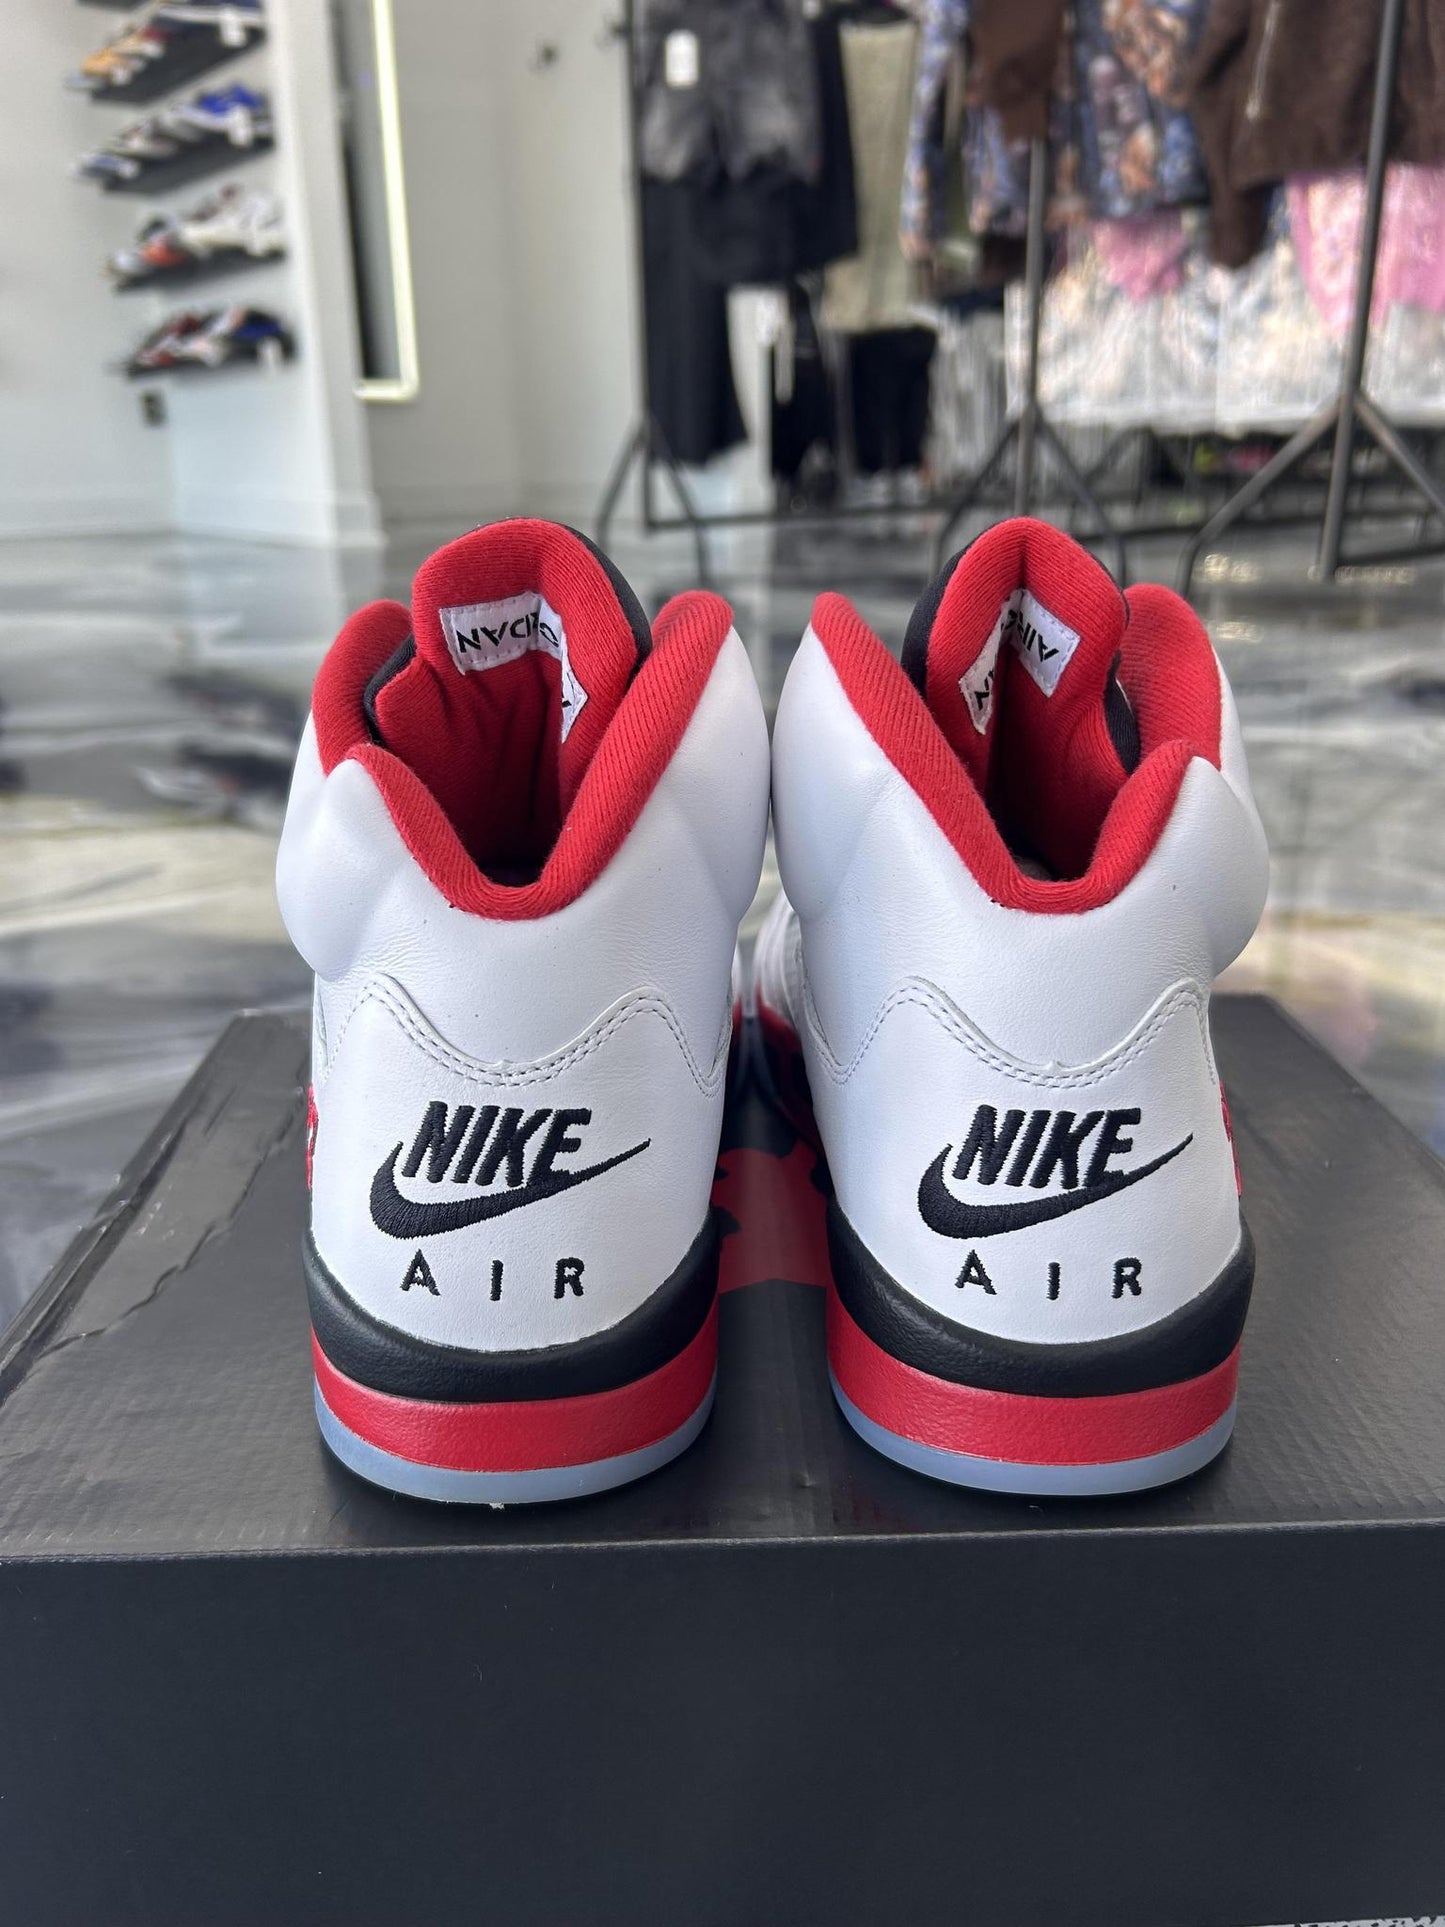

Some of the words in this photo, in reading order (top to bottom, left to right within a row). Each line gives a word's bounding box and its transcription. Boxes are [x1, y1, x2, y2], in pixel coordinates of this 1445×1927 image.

[456, 612, 559, 654] ODAN
[401, 1101, 592, 1187] NIKE
[952, 1104, 1141, 1190] NIKE
[400, 1249, 585, 1301] AIR
[955, 1249, 1142, 1300] AIR
